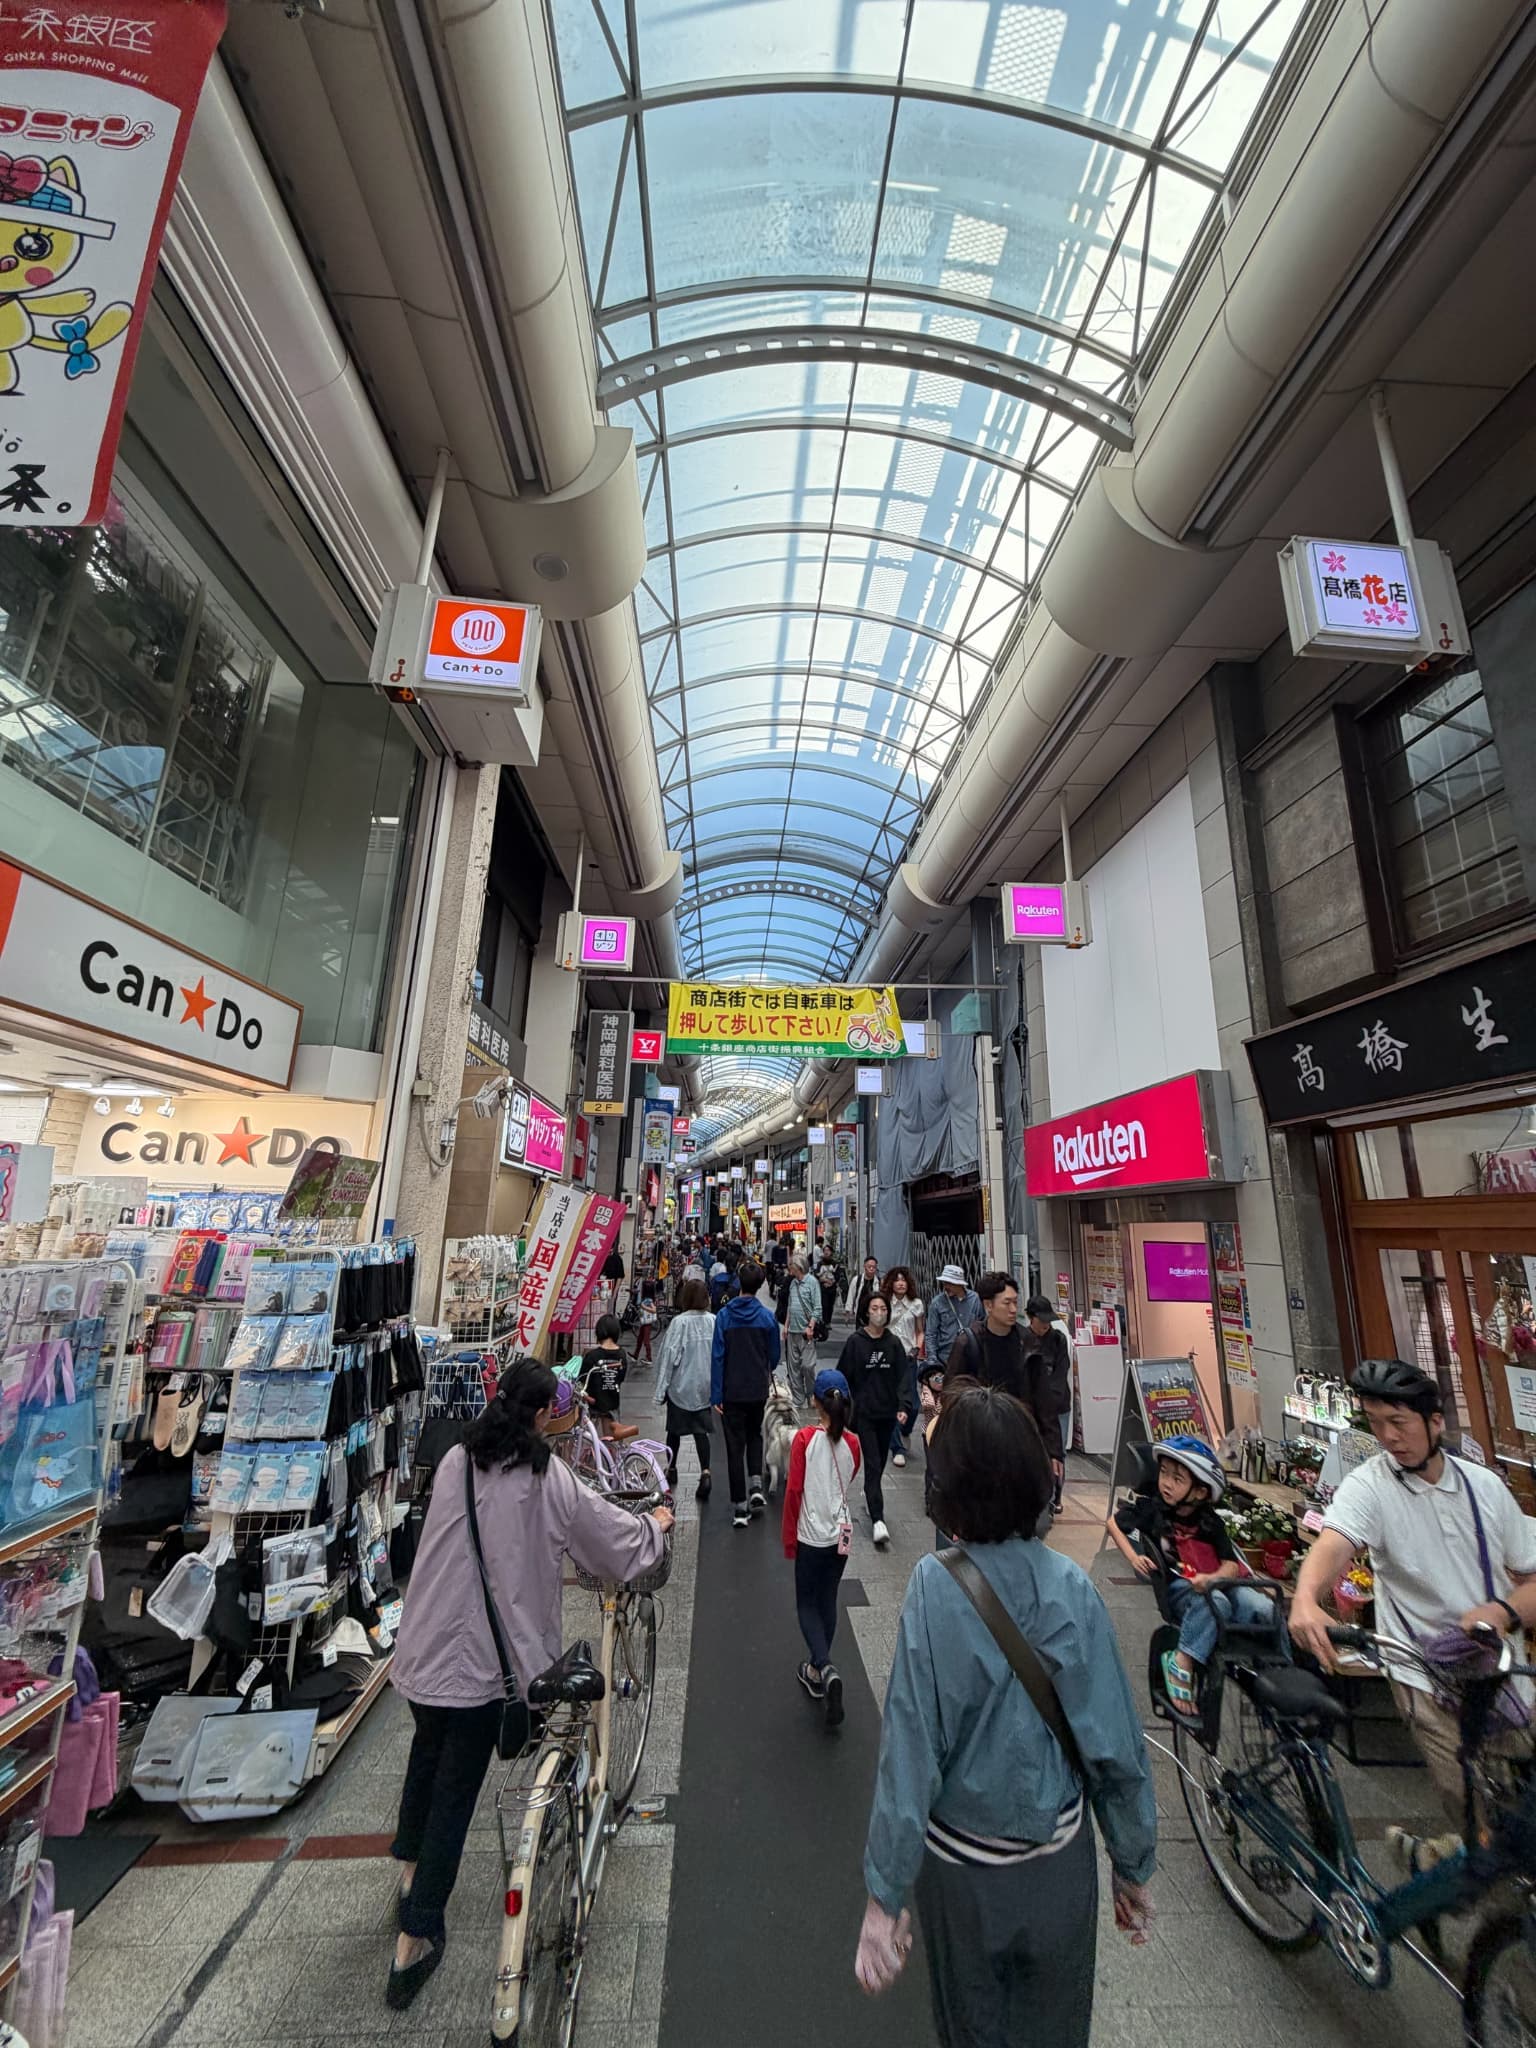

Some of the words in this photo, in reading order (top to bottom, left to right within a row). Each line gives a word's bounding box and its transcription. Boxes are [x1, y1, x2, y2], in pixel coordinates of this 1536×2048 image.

[4, 52, 46, 63] GINZA
[51, 51, 117, 72] SHOPPING
[120, 68, 149, 84] MALL
[461, 618, 496, 642] 100
[442, 661, 469, 673] Can
[484, 665, 504, 676] Do
[1017, 904, 1060, 916] Rakuten
[80, 940, 174, 1018] Can
[215, 997, 263, 1051] Do
[690, 989, 855, 1012] 商店街では自転車は
[468, 1010, 510, 1066] 歯科医院
[697, 1042, 827, 1055] 十条銀座商店街振興組合
[595, 1014, 620, 1100] 神岡歯科医院
[594, 1104, 613, 1112] 2F
[100, 1121, 206, 1167] Can
[1053, 1120, 1148, 1174] Rakuten
[552, 1227, 608, 1323] 本日特売
[1169, 1267, 1197, 1277] Rakuten
